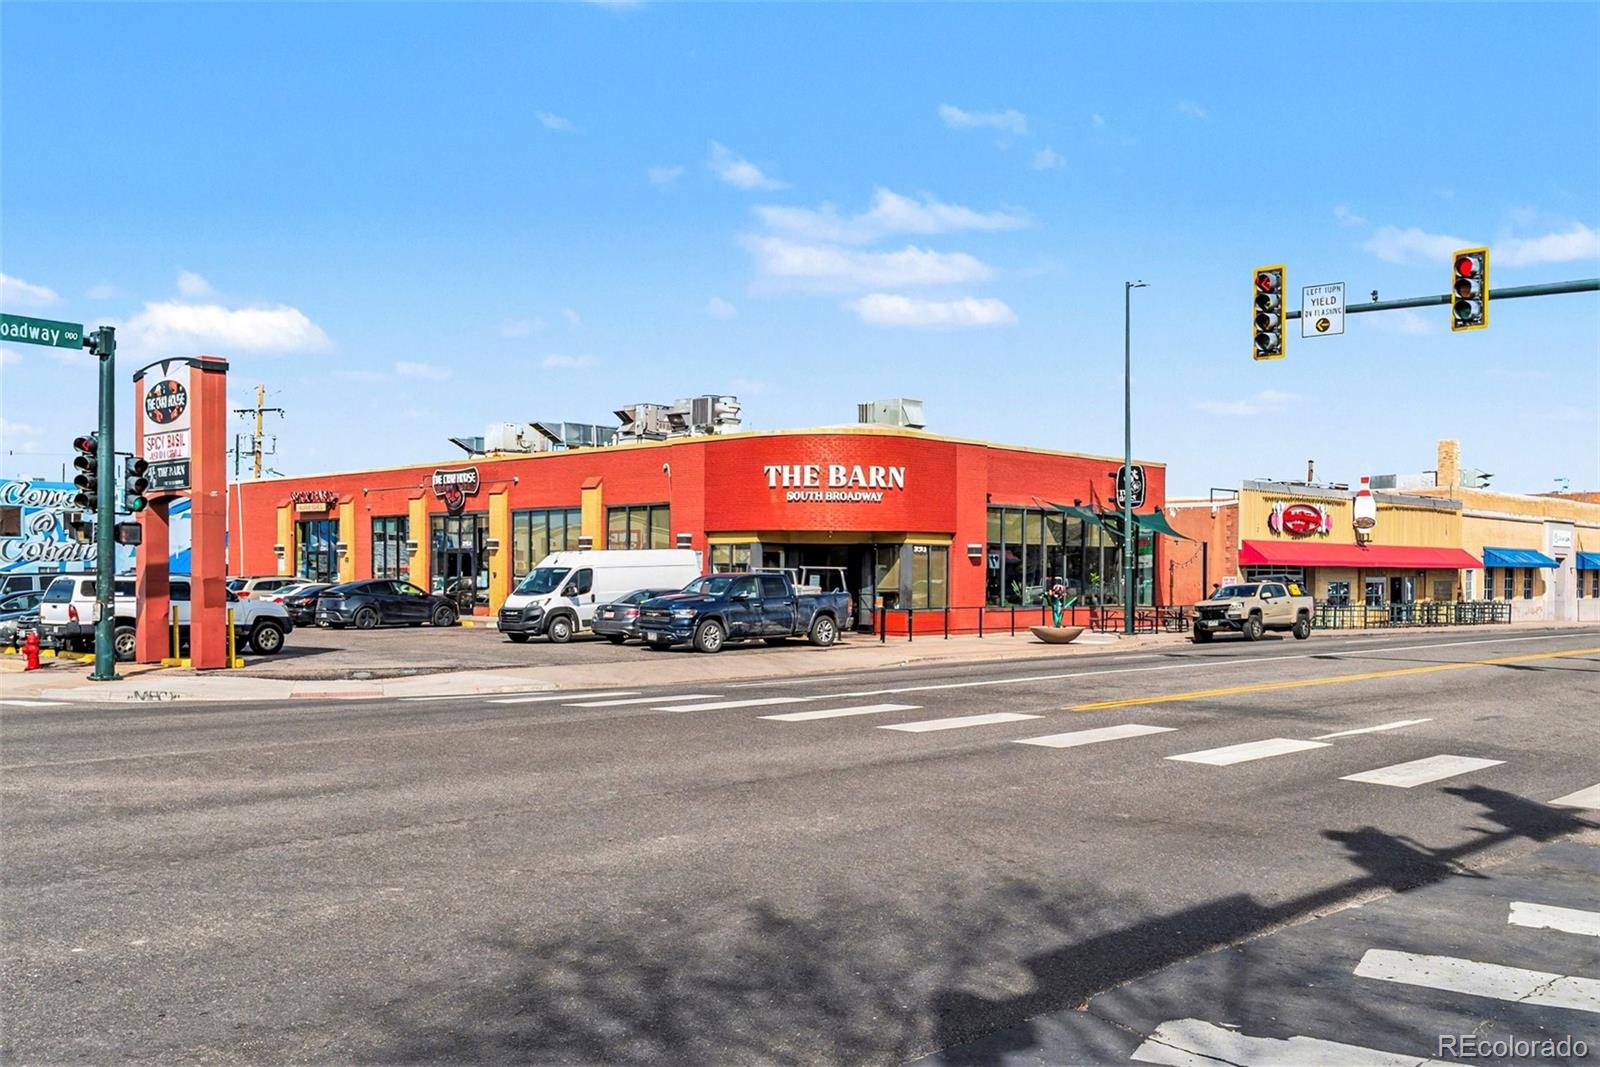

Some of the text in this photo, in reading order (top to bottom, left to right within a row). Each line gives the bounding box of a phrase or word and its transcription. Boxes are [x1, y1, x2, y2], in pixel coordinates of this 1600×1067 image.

[1311, 295, 1337, 307] YIELD
[764, 465, 905, 489] THE BARN
[786, 491, 884, 502] SOUTH BROADWAY
